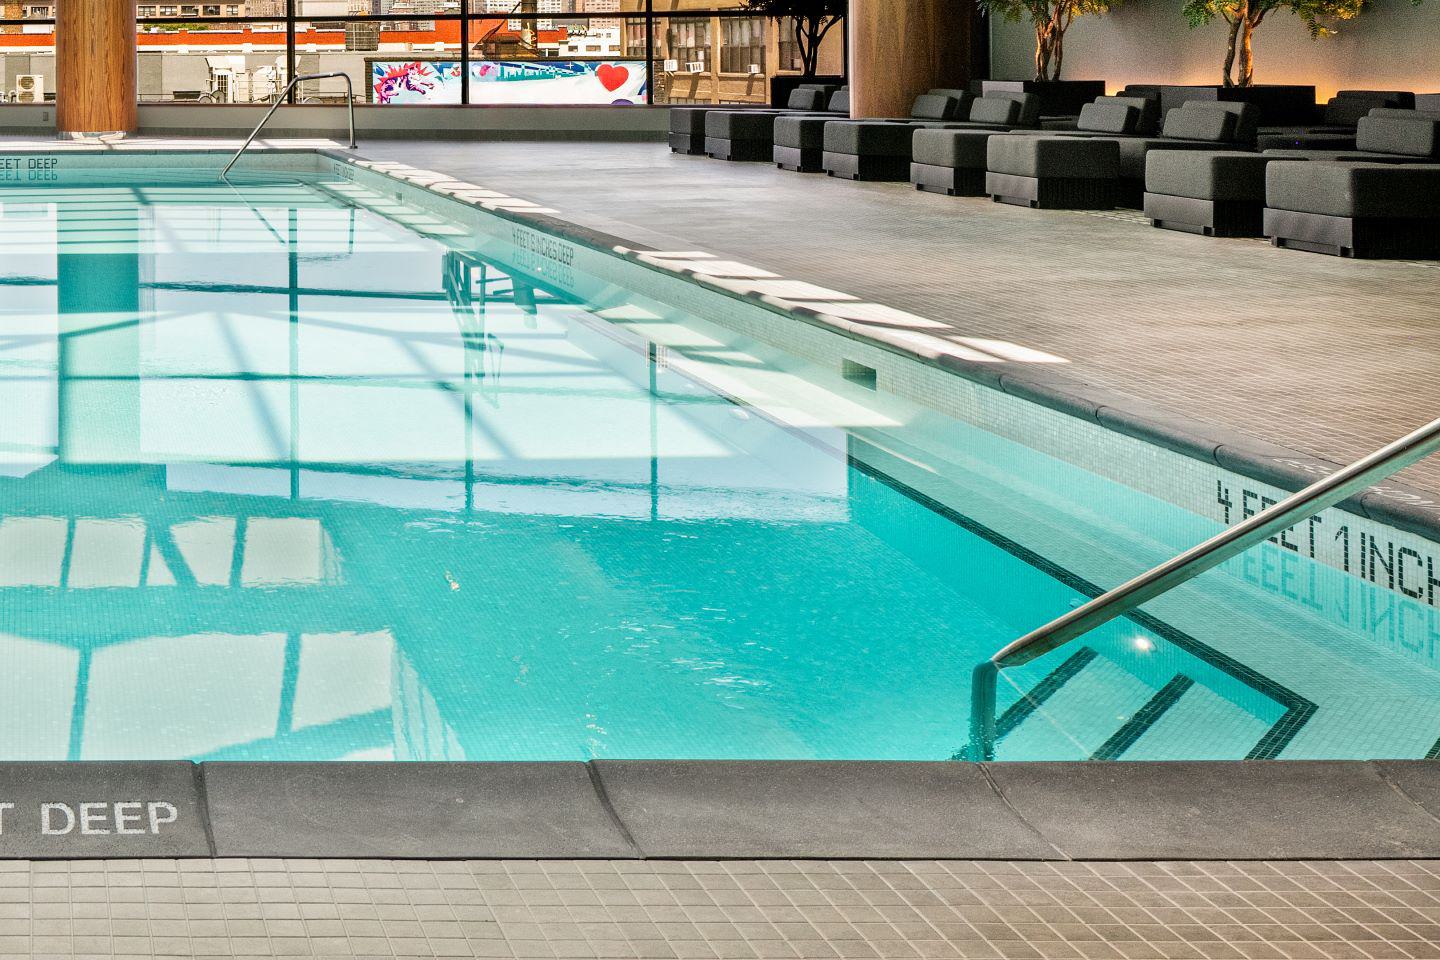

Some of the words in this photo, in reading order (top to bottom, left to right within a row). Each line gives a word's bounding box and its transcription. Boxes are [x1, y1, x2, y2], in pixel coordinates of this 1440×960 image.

[28, 158, 58, 169] DEEP
[516, 228, 530, 249] FEET
[558, 242, 573, 266] DEEP
[1217, 480, 1233, 525] 4
[1335, 525, 1350, 572] 1
[40, 801, 178, 836] DEEP
